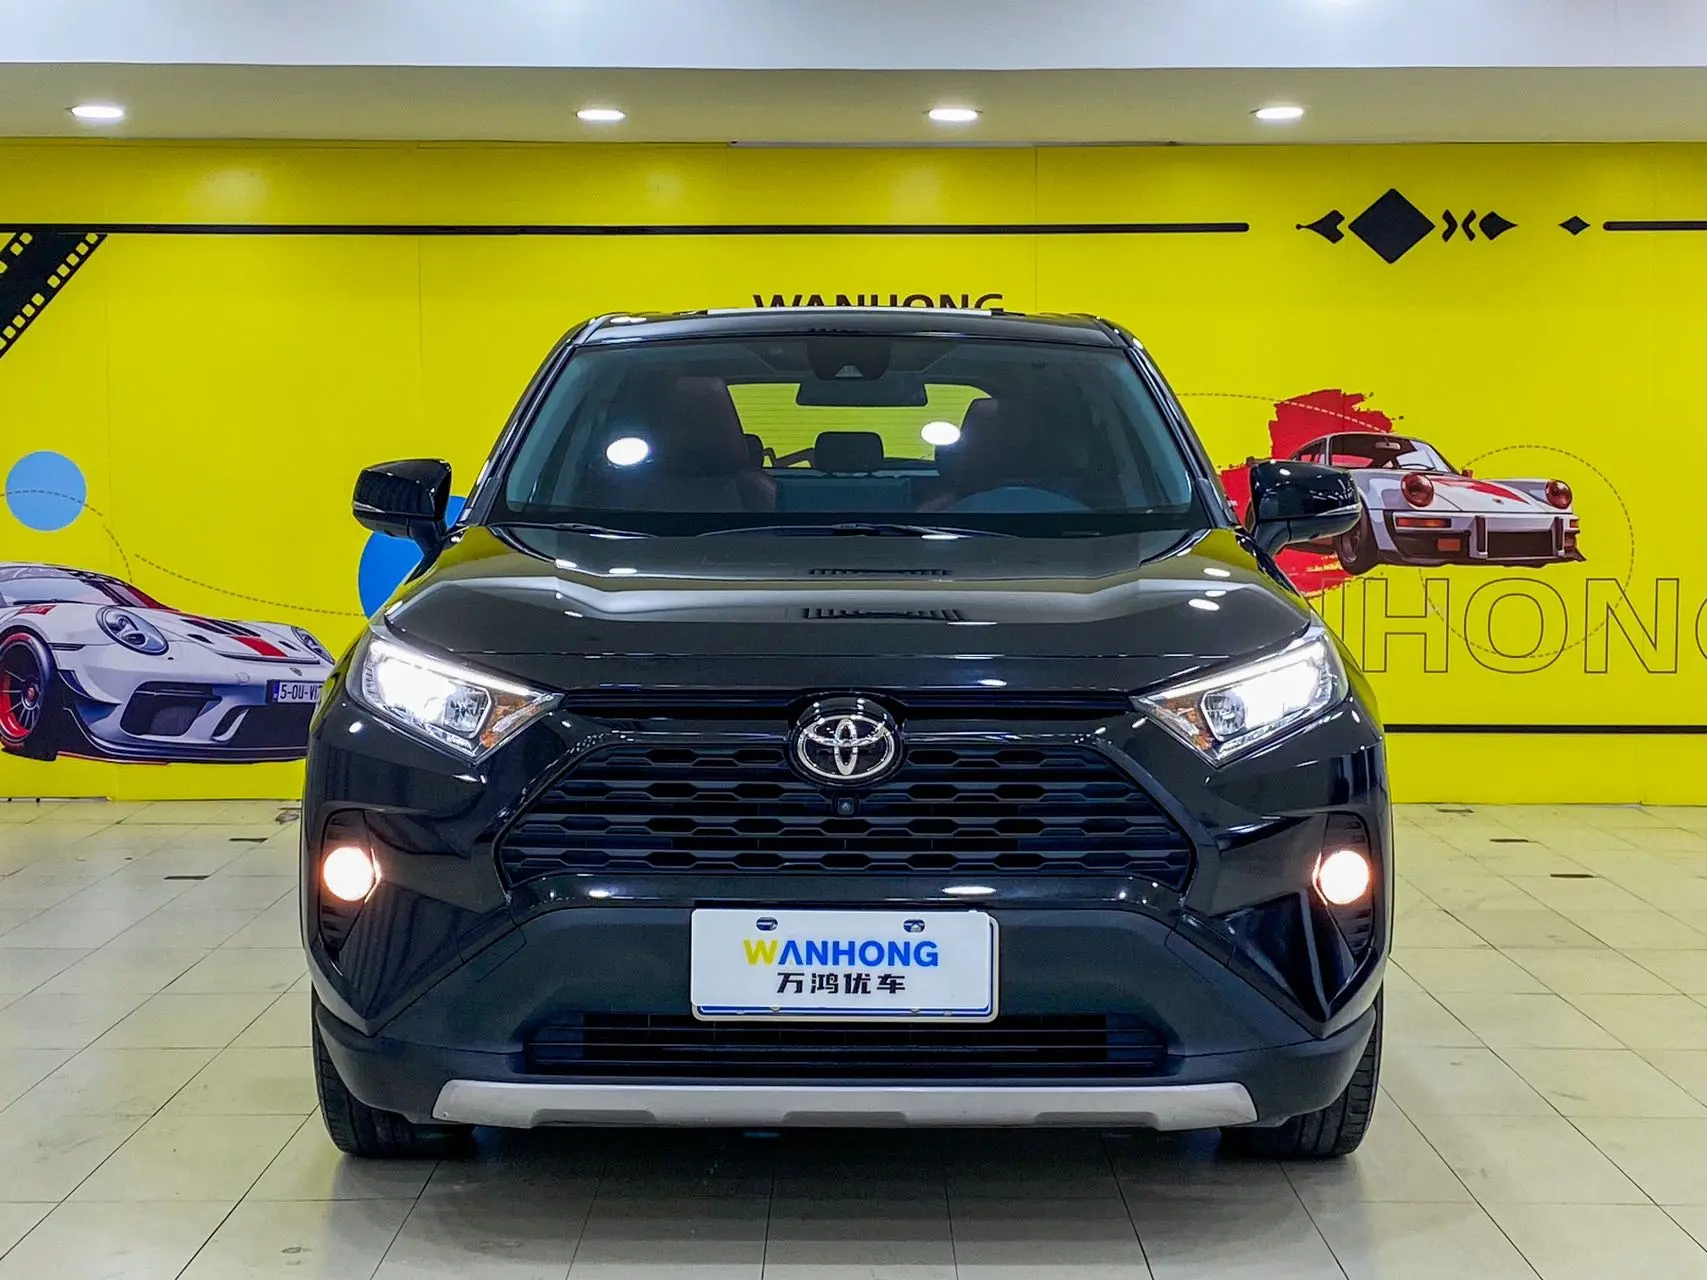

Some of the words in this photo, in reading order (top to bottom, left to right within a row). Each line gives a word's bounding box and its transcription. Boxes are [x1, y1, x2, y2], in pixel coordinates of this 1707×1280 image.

[1321, 577, 1707, 674] HON
[743, 939, 939, 967] WANHONG
[776, 972, 906, 995] 万鸿优车
